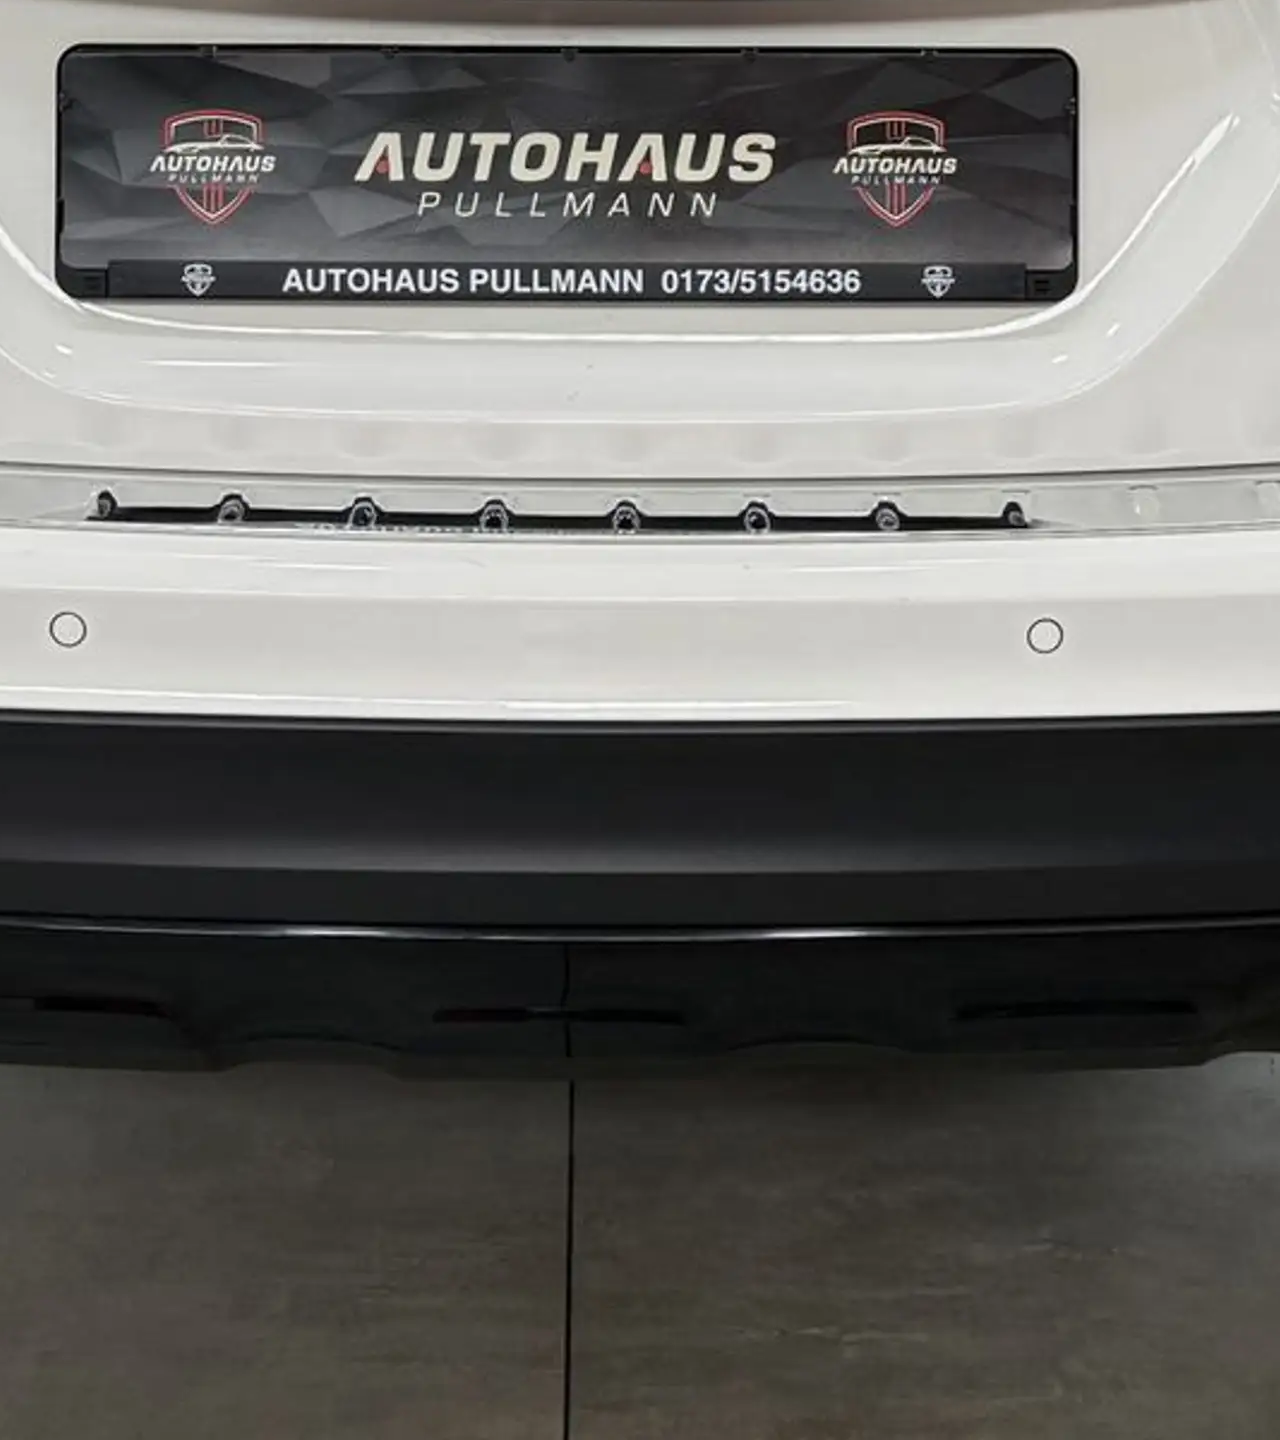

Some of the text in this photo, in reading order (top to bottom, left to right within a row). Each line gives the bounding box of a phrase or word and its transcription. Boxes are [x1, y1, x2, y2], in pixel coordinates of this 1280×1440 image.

[150, 155, 276, 173] AUTOHAUS
[354, 131, 777, 183] AUTOHAUS
[833, 157, 957, 175] AUTOHAUS
[417, 191, 718, 218] PULLMANN
[282, 268, 862, 295] AUTOHAUS PULLMANN 0173/5154636
